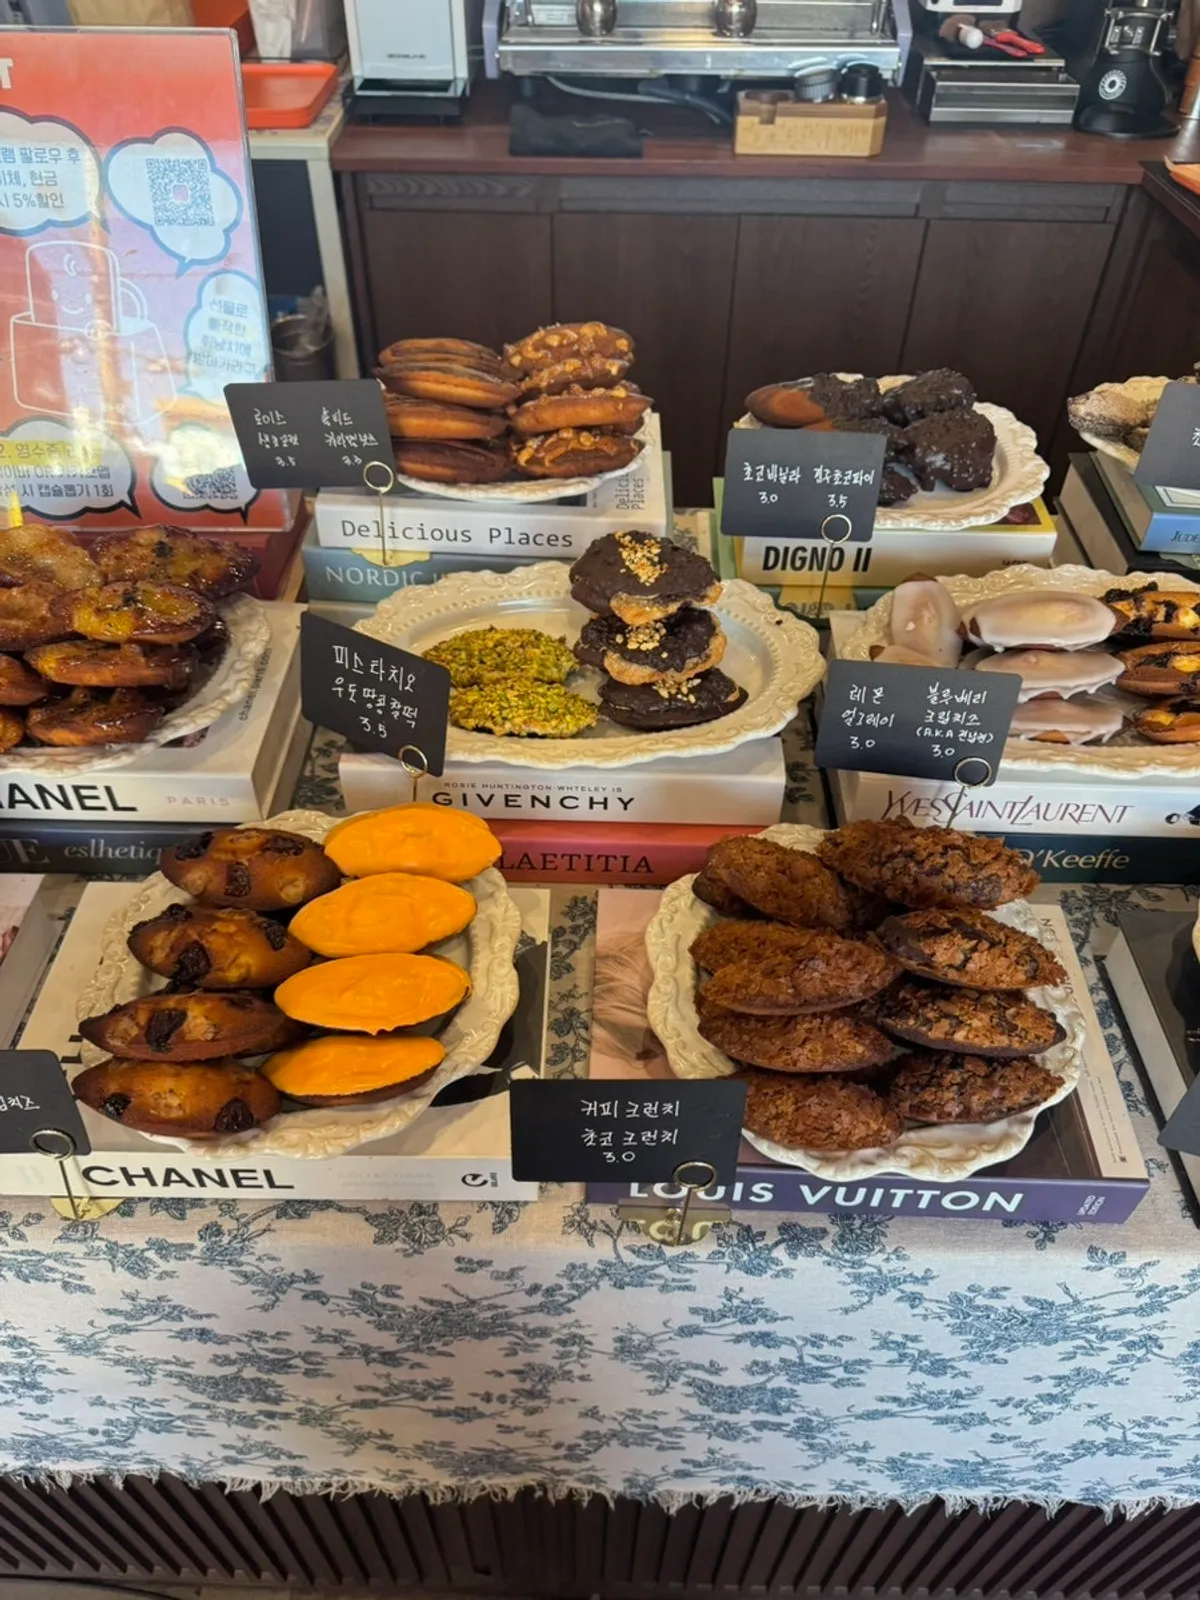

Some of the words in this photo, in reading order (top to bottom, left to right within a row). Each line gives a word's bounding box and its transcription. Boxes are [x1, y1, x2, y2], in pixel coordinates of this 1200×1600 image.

[0, 147, 16, 164] 램
[19, 147, 62, 165] 팔로우
[67, 147, 81, 165] 후
[30, 170, 58, 187] 현금
[12, 192, 65, 209] 5%할인
[254, 407, 287, 426] 로이스
[758, 491, 779, 504] 3.0
[827, 493, 848, 508] 3.5
[341, 518, 473, 545] Delicious
[489, 528, 574, 549] Places
[762, 545, 846, 573] DIGNO
[325, 566, 423, 588] NORDIC
[332, 644, 417, 693] 피스타치오
[849, 683, 886, 705] 레몬
[926, 681, 988, 706] 블루베리
[359, 715, 388, 738] 3.5
[841, 706, 896, 728] 얼그레이
[924, 709, 982, 726] 크림치즈
[849, 735, 876, 750] 3.0
[931, 744, 955, 758] 3.0
[0, 783, 138, 812] ANEL
[167, 795, 231, 807] PARIS
[432, 791, 636, 812] GIVENCHY
[500, 852, 655, 874] LAETITIA
[580, 1099, 619, 1118] 커피
[625, 1100, 680, 1118] 크런치
[581, 1127, 614, 1147] 초코
[622, 1128, 679, 1146] 크런치
[602, 1151, 636, 1163] 3.0
[82, 1165, 295, 1190] CHANEL
[629, 1182, 774, 1203] LOUIS
[799, 1184, 1024, 1213] VUITTON
